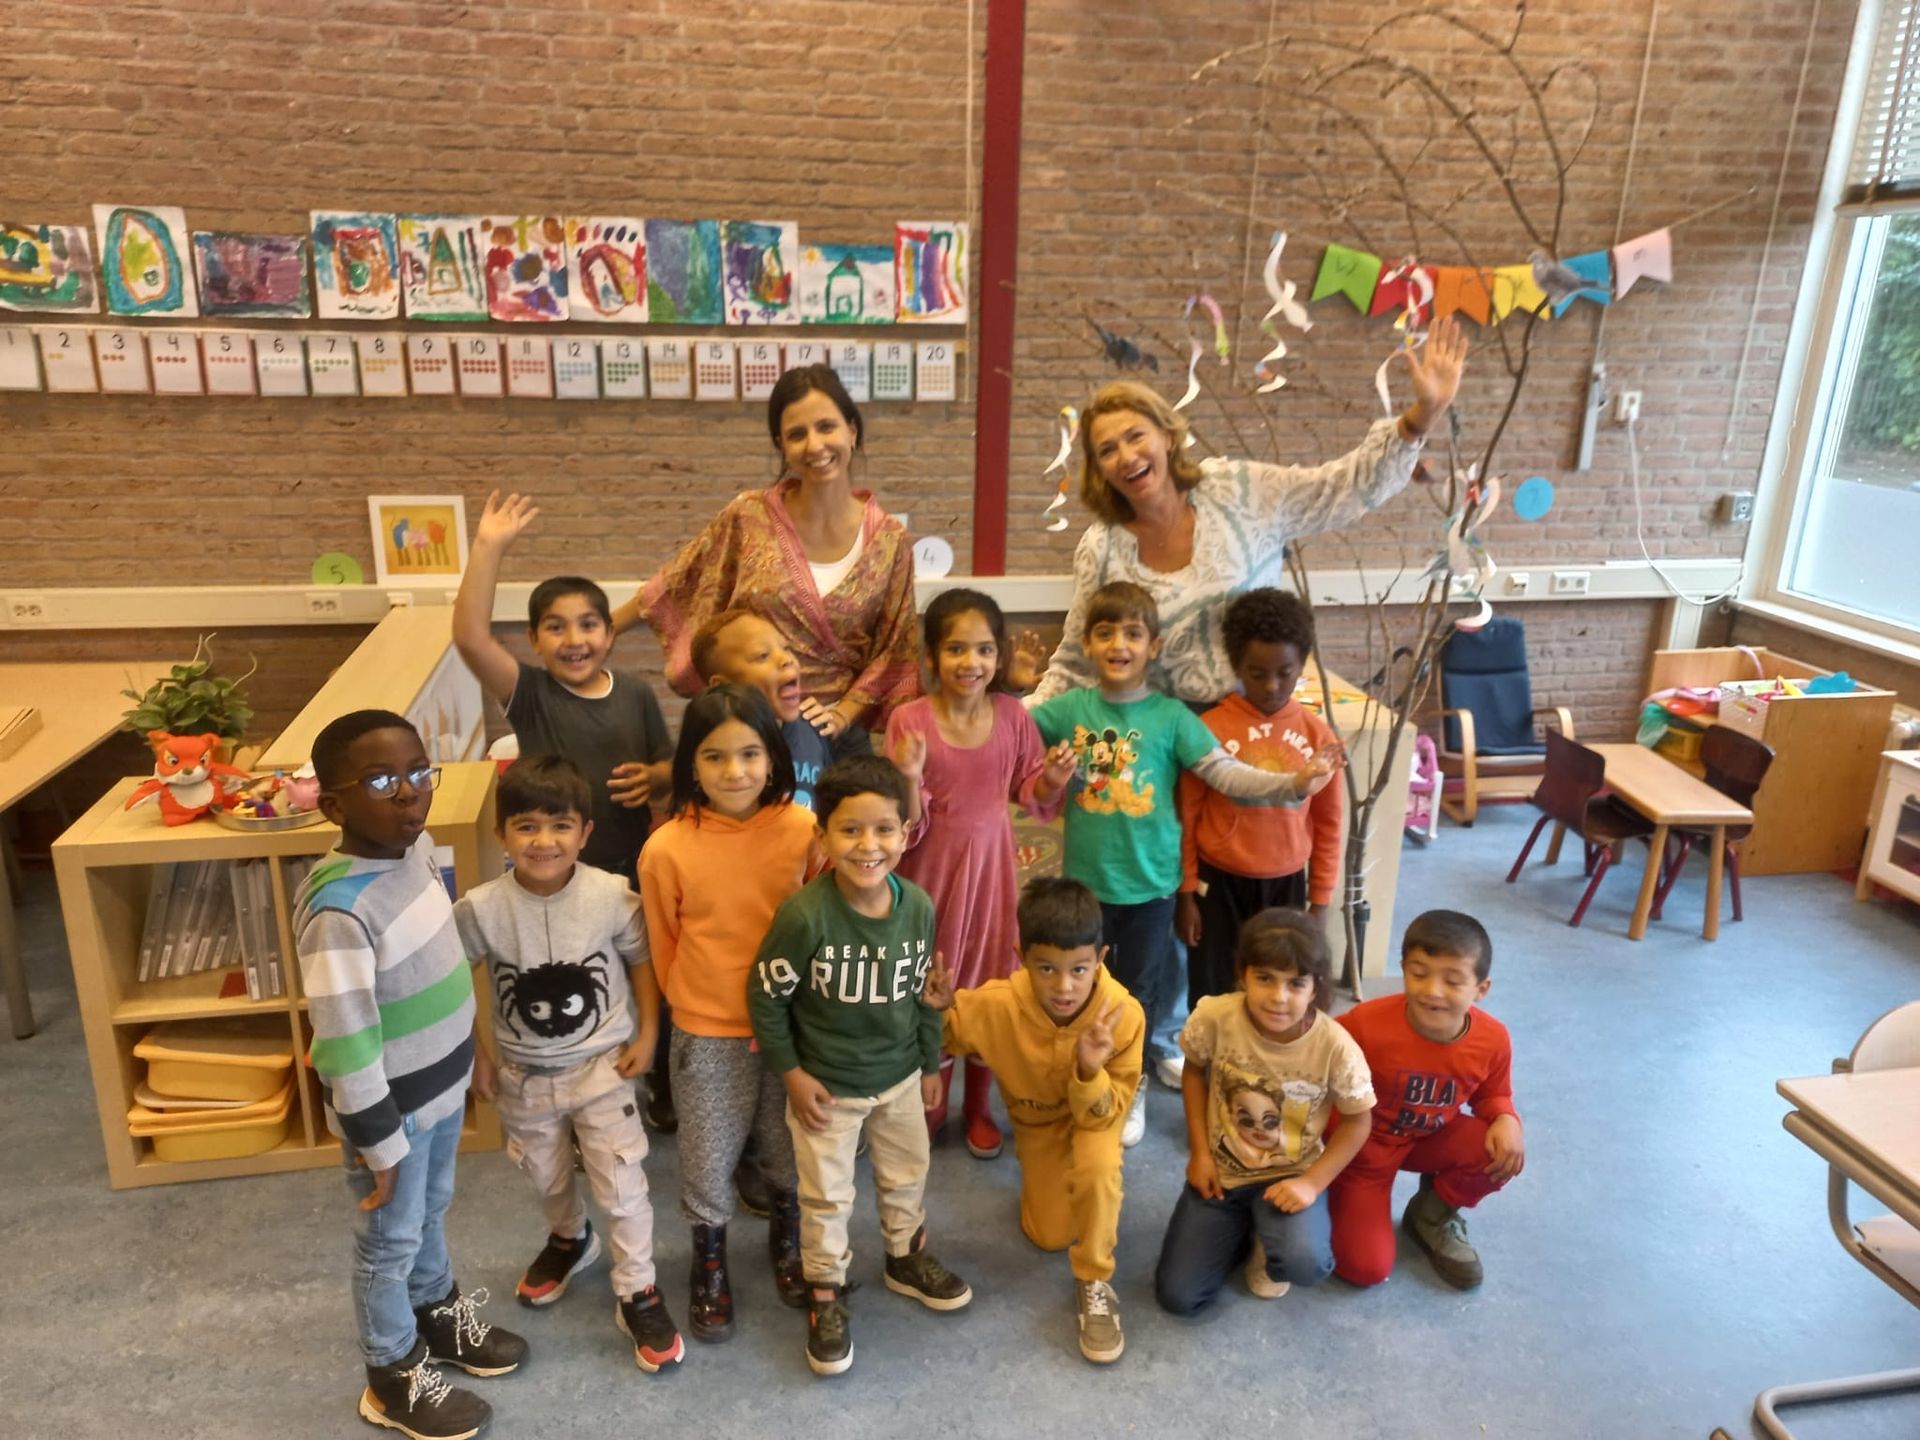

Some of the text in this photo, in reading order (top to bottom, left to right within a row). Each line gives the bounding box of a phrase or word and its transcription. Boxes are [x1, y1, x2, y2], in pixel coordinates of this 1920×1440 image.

[58, 331, 70, 348] 2
[112, 333, 125, 350] 3
[167, 335, 179, 350] 4
[220, 335, 231, 352] 5
[273, 338, 284, 353] 6
[325, 337, 337, 353] 7
[374, 337, 385, 354] 8
[422, 338, 433, 354] 9
[471, 339, 486, 355] 10
[522, 339, 532, 356] 11
[567, 341, 581, 357] 12
[616, 343, 630, 359] 13
[663, 343, 677, 358] 14
[709, 343, 723, 360] 15
[753, 344, 767, 360] 16
[798, 345, 812, 360] 17
[843, 346, 857, 363] 18
[887, 345, 900, 360] 19
[927, 346, 945, 361] 20
[922, 546, 936, 568] 4
[330, 563, 345, 585] 5
[1247, 722, 1274, 742] AT
[816, 944, 888, 961] REAK
[758, 957, 803, 999] 19
[1404, 1074, 1457, 1108] BLA
